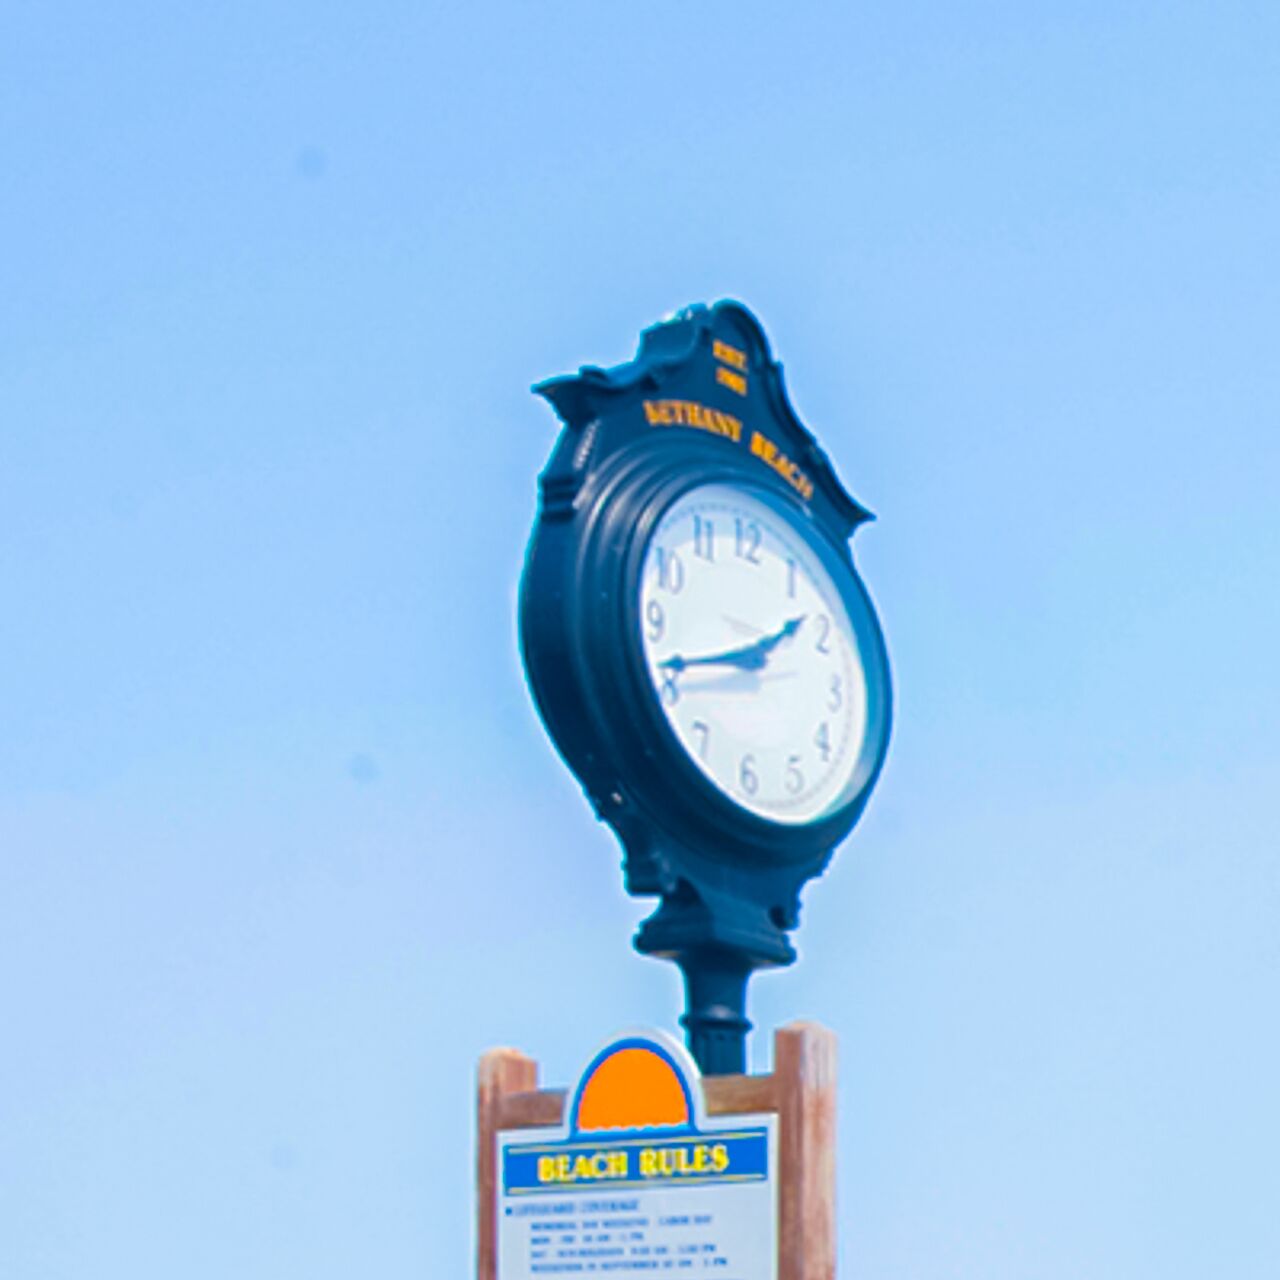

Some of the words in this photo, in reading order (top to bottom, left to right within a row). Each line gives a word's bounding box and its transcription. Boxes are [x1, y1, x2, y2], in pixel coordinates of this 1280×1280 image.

[643, 400, 742, 442] BETHANY
[750, 431, 813, 499] BEACH
[693, 514, 716, 564] 11
[735, 516, 762, 566] 12
[655, 546, 685, 596] 10
[646, 600, 665, 643] 9
[816, 613, 831, 655] 2
[738, 755, 760, 795] 6
[537, 1151, 628, 1182] BEACH
[639, 1144, 730, 1175] RULES
